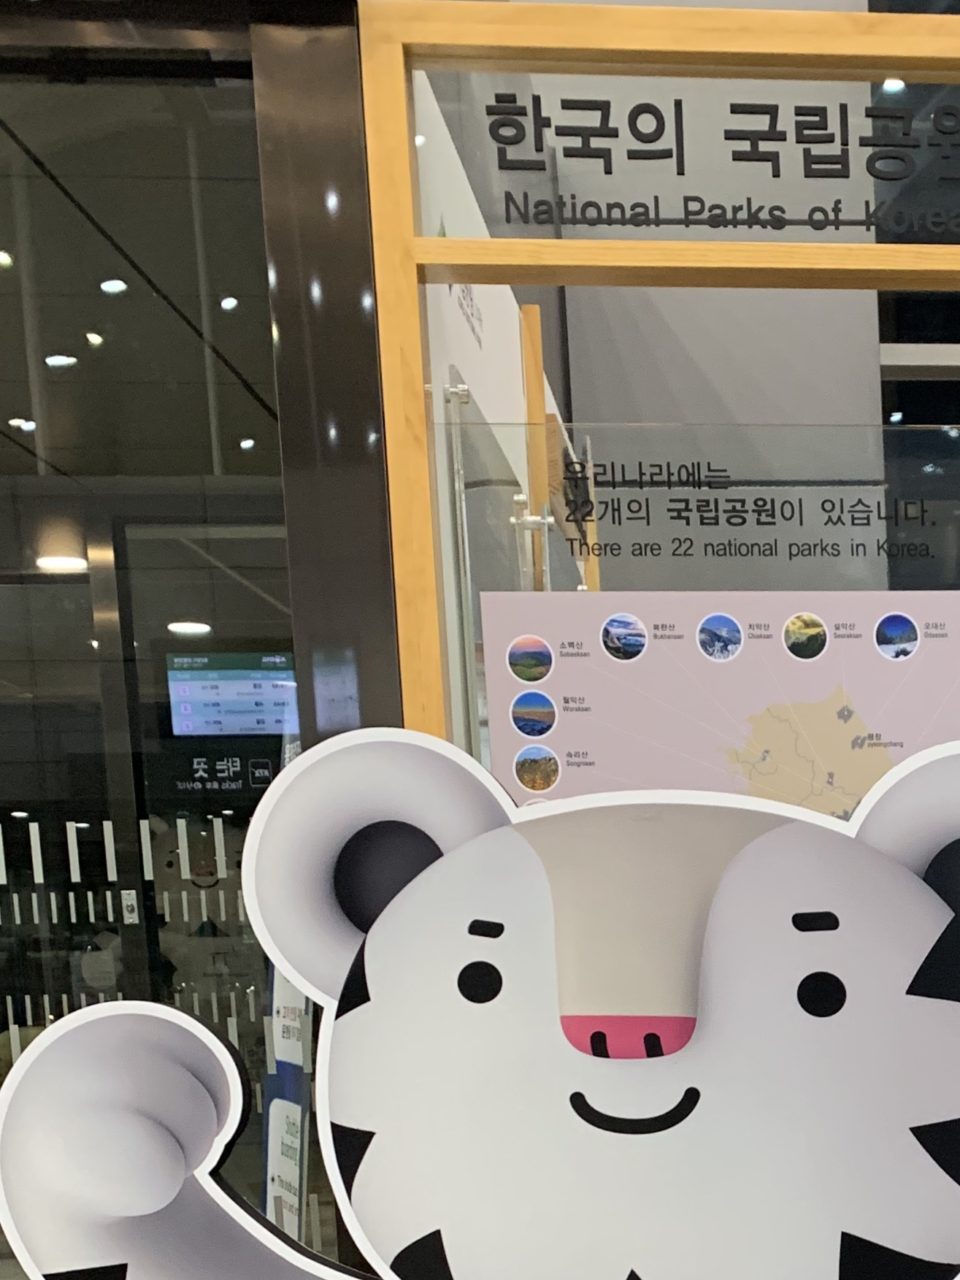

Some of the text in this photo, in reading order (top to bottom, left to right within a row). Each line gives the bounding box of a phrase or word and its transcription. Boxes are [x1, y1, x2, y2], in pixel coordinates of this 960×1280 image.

[485, 92, 686, 176] 한국의
[503, 190, 661, 228] National
[682, 194, 788, 231] Parks
[807, 198, 843, 231] of
[562, 460, 731, 490] 우리나라에는
[564, 496, 937, 527] 22개의 국립공원이 있습니다.
[564, 537, 936, 561] There are 22 national parks in Korea.
[833, 622, 857, 631] 설악산
[923, 622, 947, 631] 오대산
[559, 641, 584, 650] 소백산
[565, 750, 589, 759] 속리산
